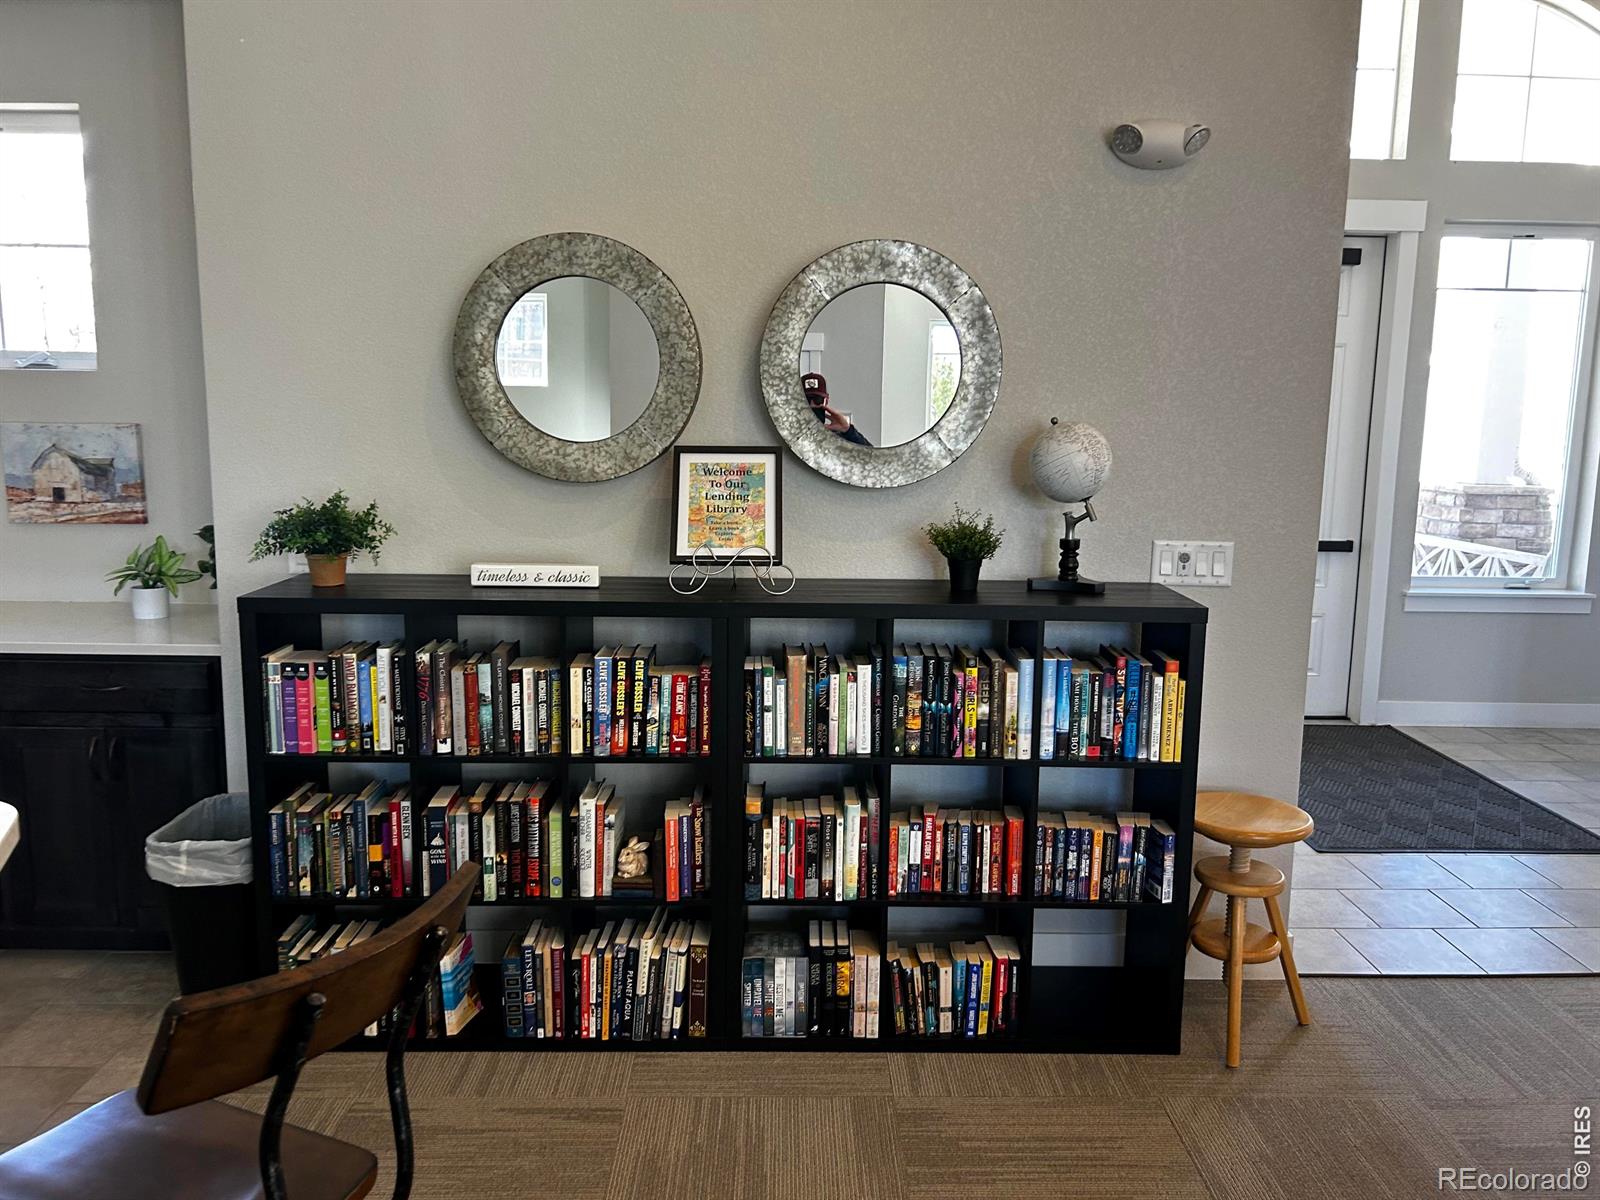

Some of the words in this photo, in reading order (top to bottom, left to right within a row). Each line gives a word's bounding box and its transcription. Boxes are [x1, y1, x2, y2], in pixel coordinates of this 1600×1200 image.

[703, 467, 752, 476] Welcome
[709, 480, 721, 488] To
[725, 480, 745, 488] Our
[705, 492, 750, 502] Lending
[706, 505, 748, 515] Library
[477, 569, 529, 582] timeless
[533, 572, 544, 582] &
[547, 570, 591, 583] classic
[344, 657, 356, 680] DAVID
[599, 661, 607, 680] CLIVE
[618, 661, 626, 680] CLIVE
[635, 660, 644, 680] CLIVE
[819, 659, 827, 680] VINCE
[908, 660, 916, 686] GRISHAM
[416, 676, 430, 700] 1776
[512, 682, 520, 706] MICHAEL
[538, 680, 546, 702] MICHAEL
[552, 680, 560, 707] MICHAEL
[599, 682, 607, 713] CUSSLER
[634, 681, 644, 713] CUSSLER
[676, 682, 684, 694] TOM
[819, 684, 827, 708] FLYNN
[927, 674, 935, 699] GRISHAM
[346, 683, 358, 720] BALDACCI
[616, 681, 625, 716] CUSSLER'S
[967, 690, 976, 712] GIRLS
[1116, 696, 1124, 723] LIVES
[512, 706, 520, 731] CONNELLY
[539, 703, 547, 728] CONNELLY
[553, 706, 561, 736] CONNELLY
[1071, 737, 1079, 755] BOY
[402, 806, 410, 824] GLENN
[510, 804, 520, 818] JAMES
[528, 803, 539, 822] JAMES
[511, 819, 520, 842] PATTERSON
[694, 818, 703, 836] Snow
[925, 817, 933, 840] HARLAN
[528, 823, 539, 857] PATTERSON
[924, 840, 932, 860] COBEN
[528, 858, 539, 880] ESCAPE
[524, 949, 532, 968] LET'S
[524, 969, 533, 990] ROLL!
[625, 970, 634, 997] PLANET
[836, 966, 846, 990] MARK
[744, 982, 752, 1007] SHATTER
[754, 978, 762, 1006] UNRAVEL
[765, 980, 774, 1004] IGNITE
[624, 998, 632, 1020] AQUA
[754, 1008, 762, 1018] ME
[765, 1007, 773, 1016] ME
[776, 1008, 783, 1018] ME
